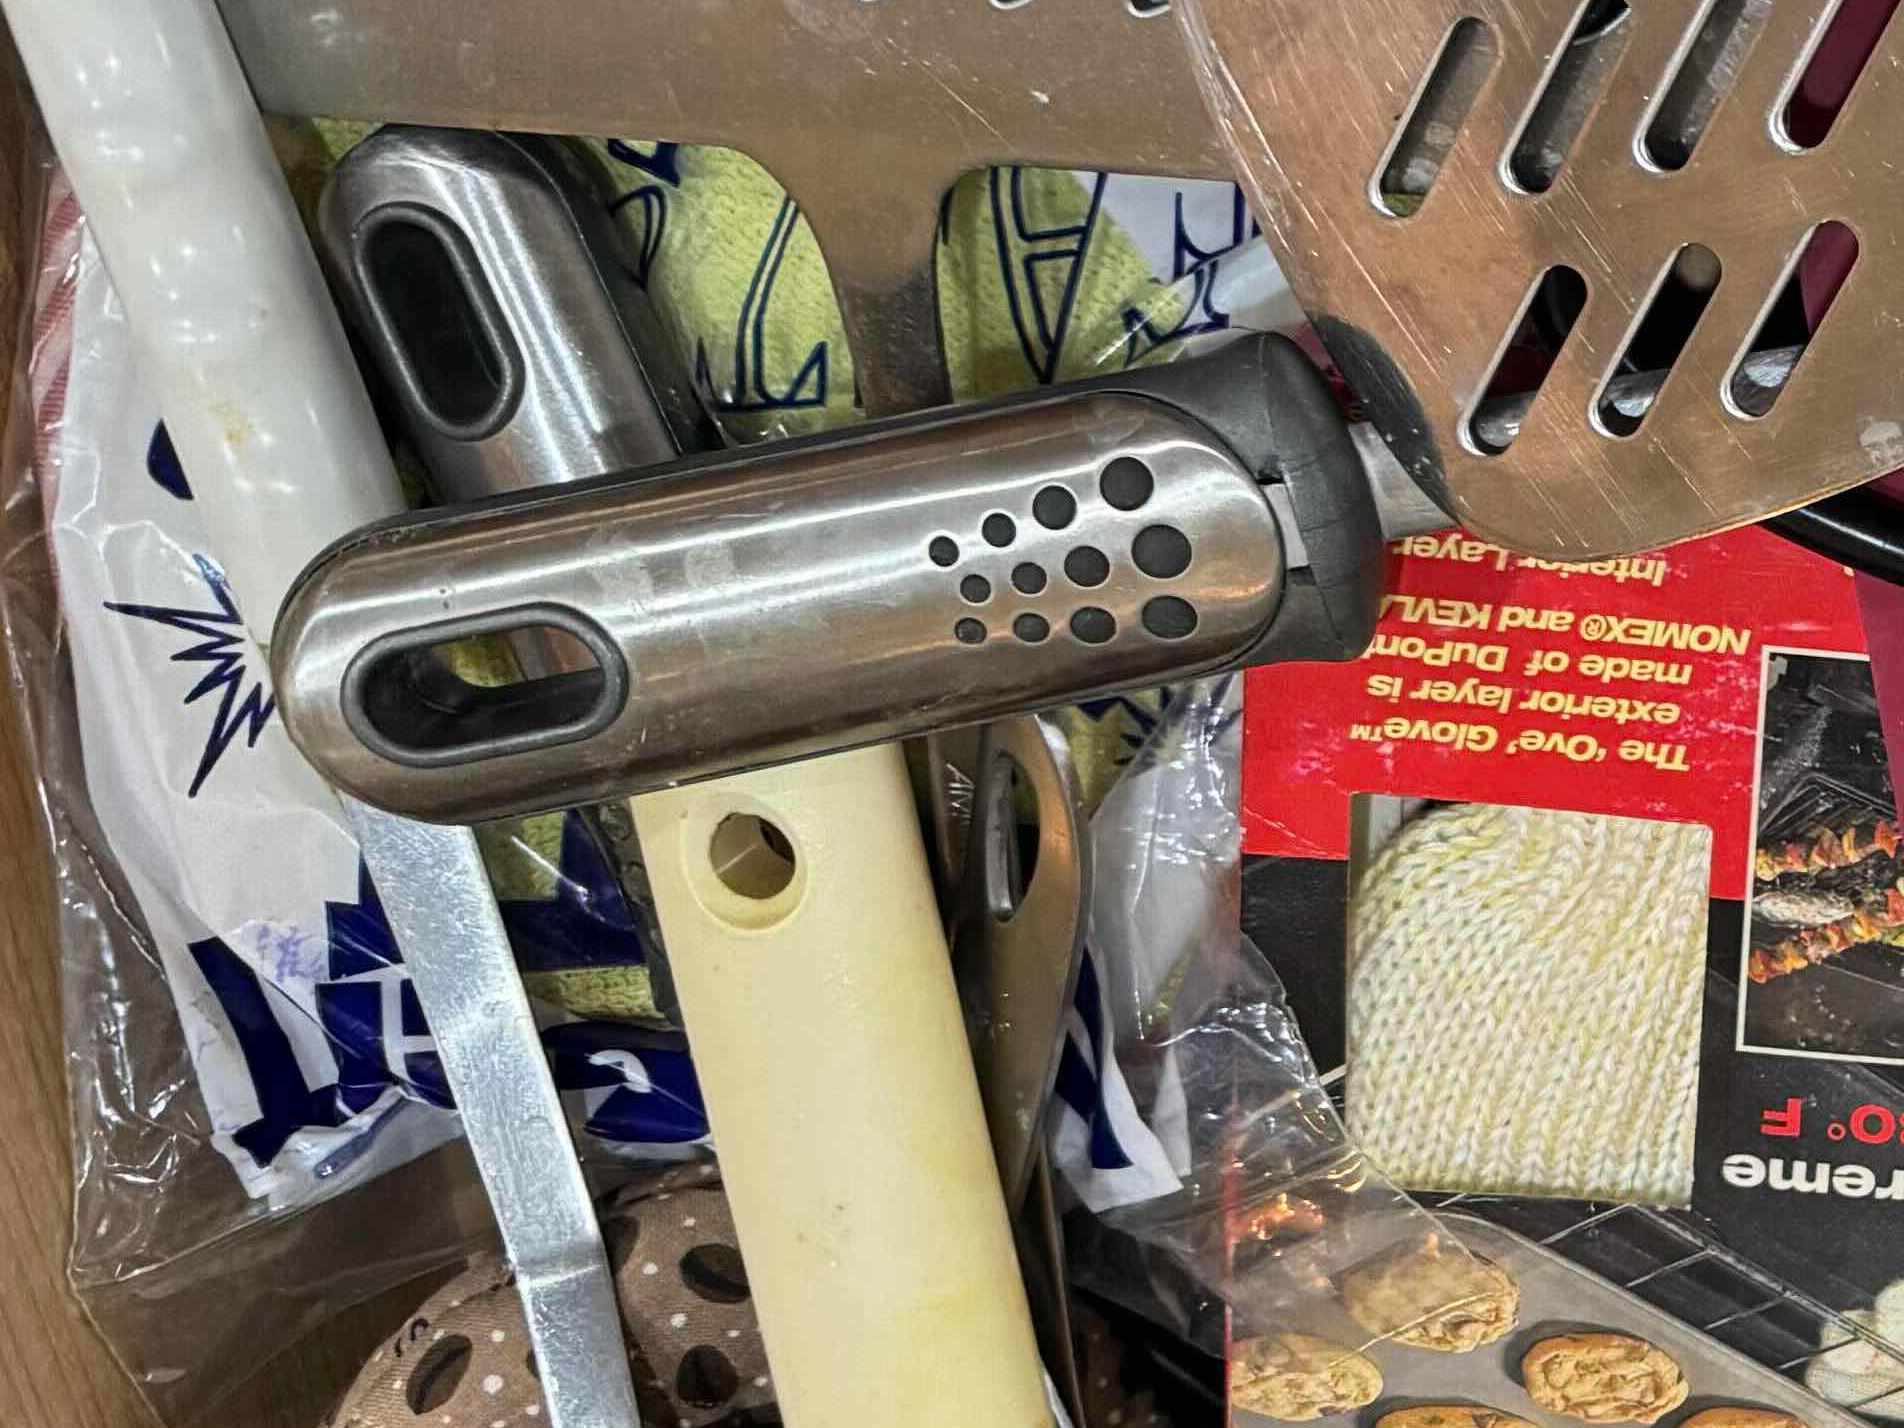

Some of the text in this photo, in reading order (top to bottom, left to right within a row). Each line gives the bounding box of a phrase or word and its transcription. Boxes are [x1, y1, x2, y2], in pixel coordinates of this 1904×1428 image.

[1500, 606, 1574, 632] and
[1524, 650, 1569, 676] of
[1579, 656, 1693, 685] made
[1367, 674, 1681, 725] exterior layer is
[1620, 739, 1691, 772] The
[1760, 1096, 1803, 1137] F
